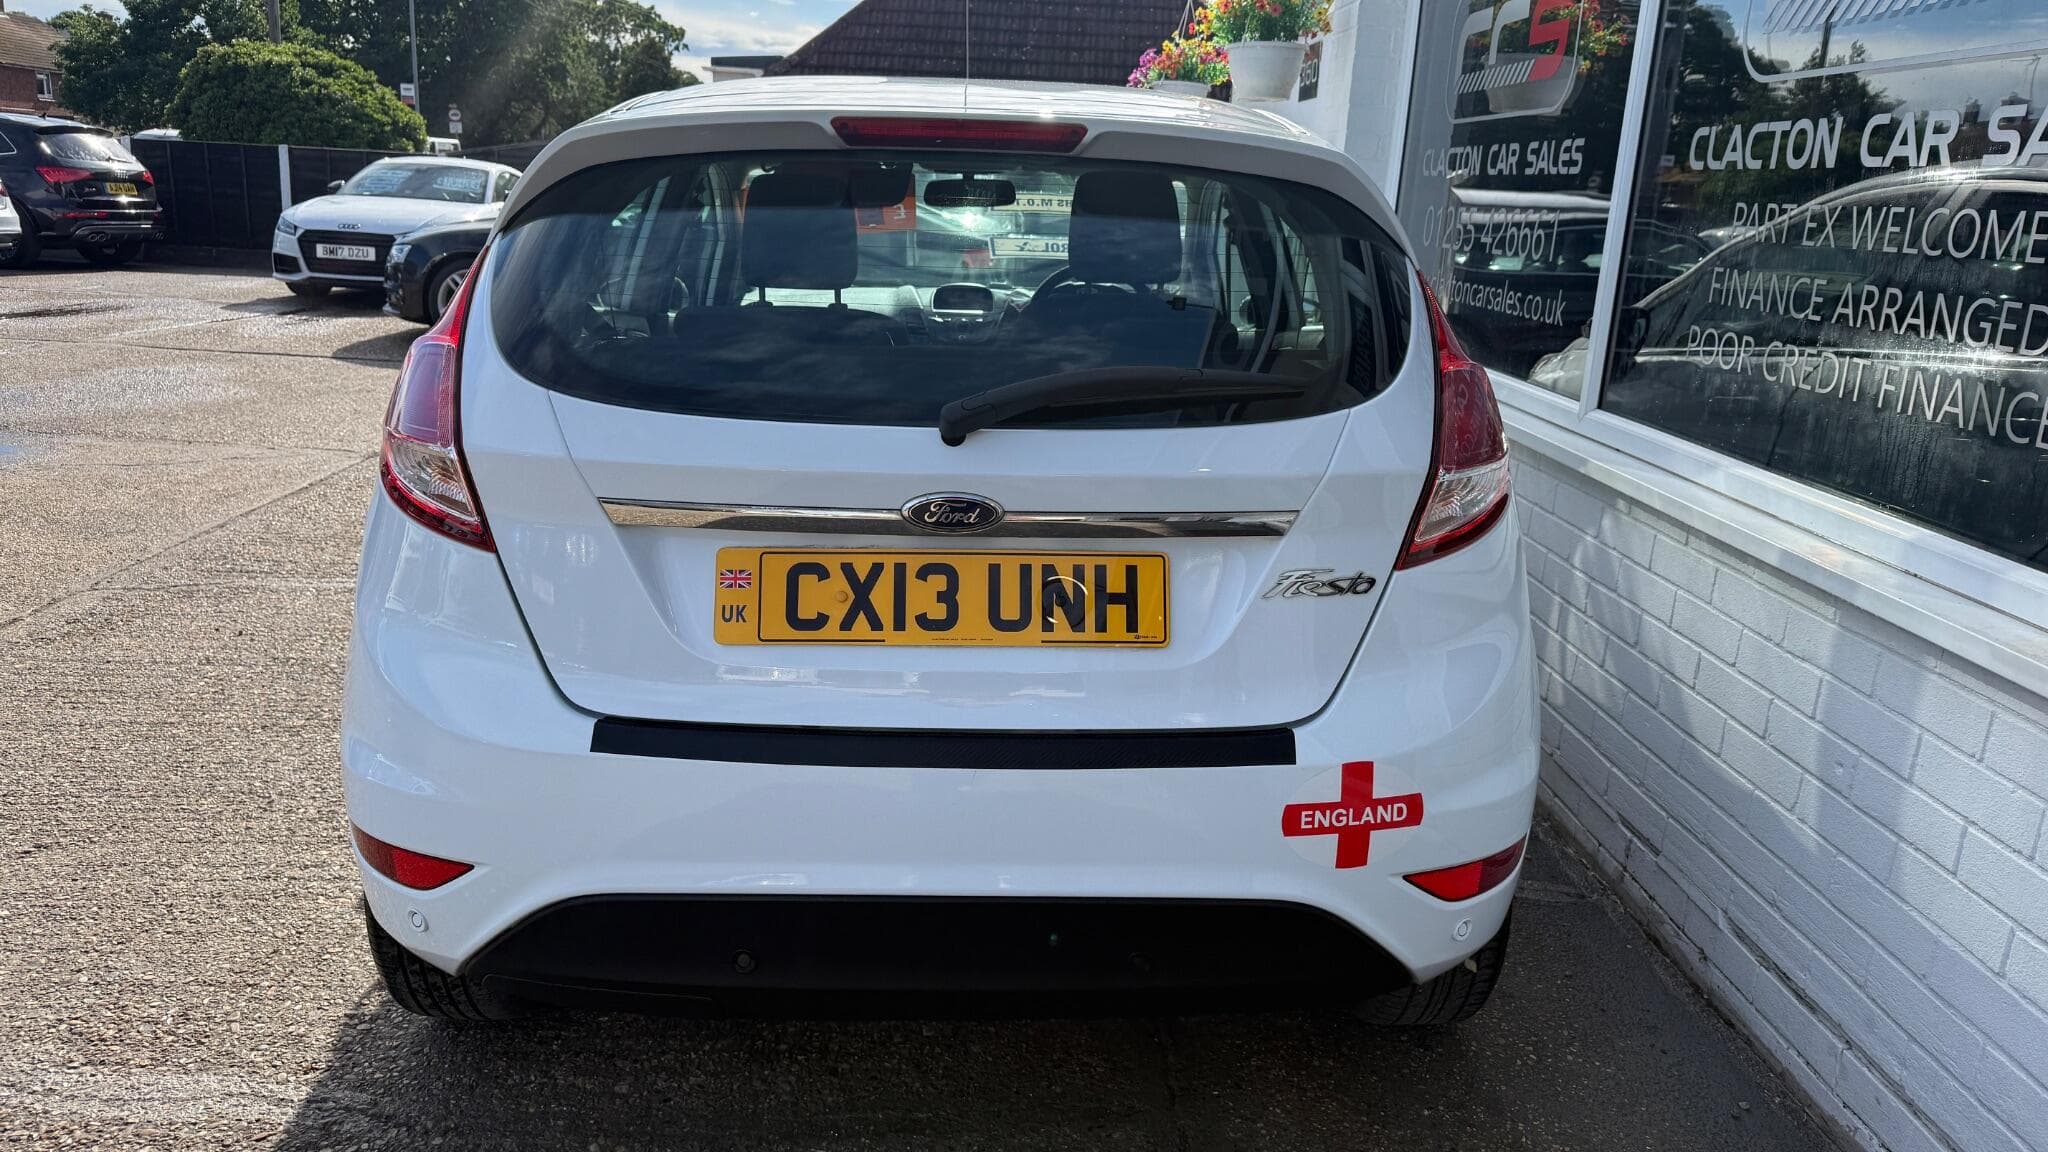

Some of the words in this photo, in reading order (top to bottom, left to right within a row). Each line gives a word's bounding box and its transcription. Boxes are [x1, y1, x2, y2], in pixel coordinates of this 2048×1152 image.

[1422, 145, 1483, 177] CLACTON
[1487, 142, 1520, 176] CAR
[1525, 137, 1585, 175] SALES
[1689, 116, 1844, 171] CLACTON
[1860, 109, 1960, 168] CAR
[322, 246, 345, 256] BM17
[349, 248, 369, 258] DZU
[1423, 205, 1478, 251] 01255
[1480, 207, 1560, 262] 426661
[1732, 202, 1798, 246] PART
[1802, 204, 1842, 249] EX
[1852, 206, 2048, 264] WELCOME
[1708, 267, 1827, 321] FINANCE
[1832, 282, 2048, 356] ARRANGED
[1686, 325, 1754, 375] POOR
[1762, 341, 1871, 402] CREDIT
[924, 501, 980, 524] Ford
[785, 562, 959, 632] CX13
[988, 562, 1138, 633] UNH
[1262, 568, 1376, 599] Fiesta
[721, 604, 747, 623] UK
[1301, 803, 1407, 829] ENGLAND
